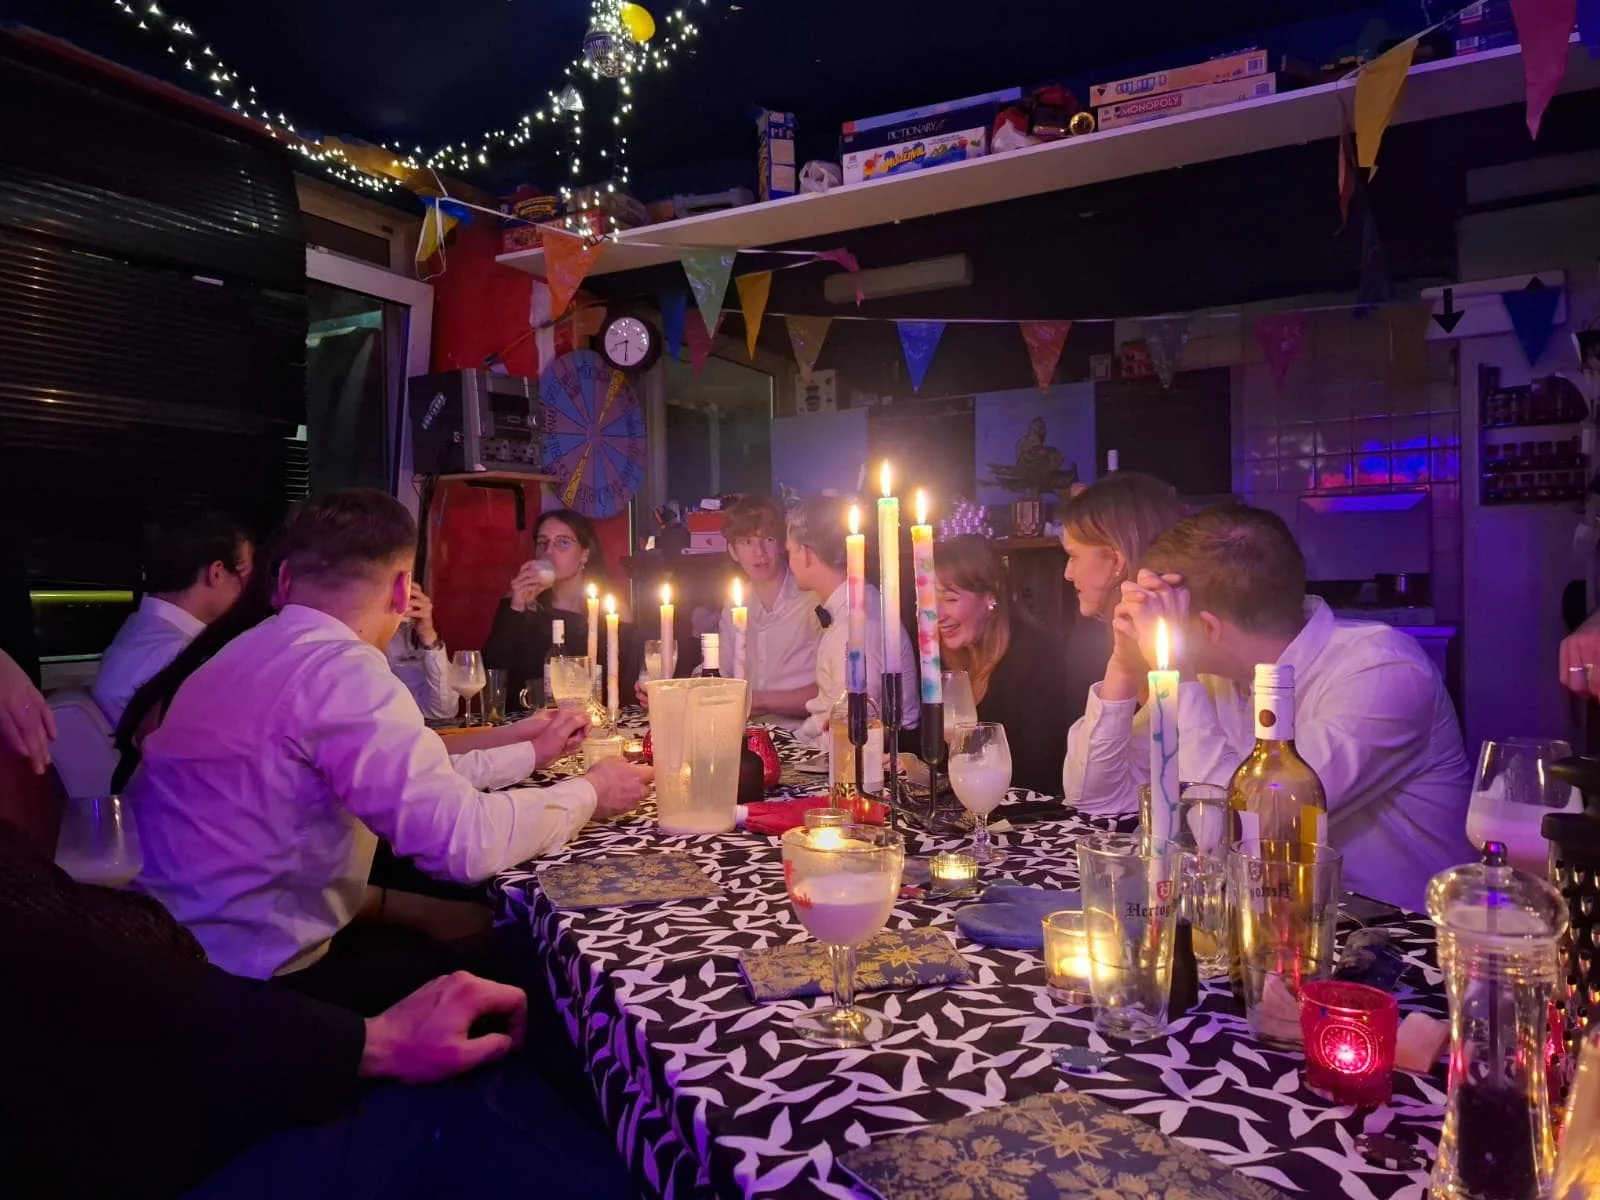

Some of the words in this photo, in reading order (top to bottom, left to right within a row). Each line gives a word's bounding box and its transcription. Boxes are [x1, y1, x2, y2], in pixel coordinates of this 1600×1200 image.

[1121, 95, 1180, 115] MONOPOLY
[888, 121, 937, 141] PICTIONARY
[1125, 901, 1171, 917] Hertog
